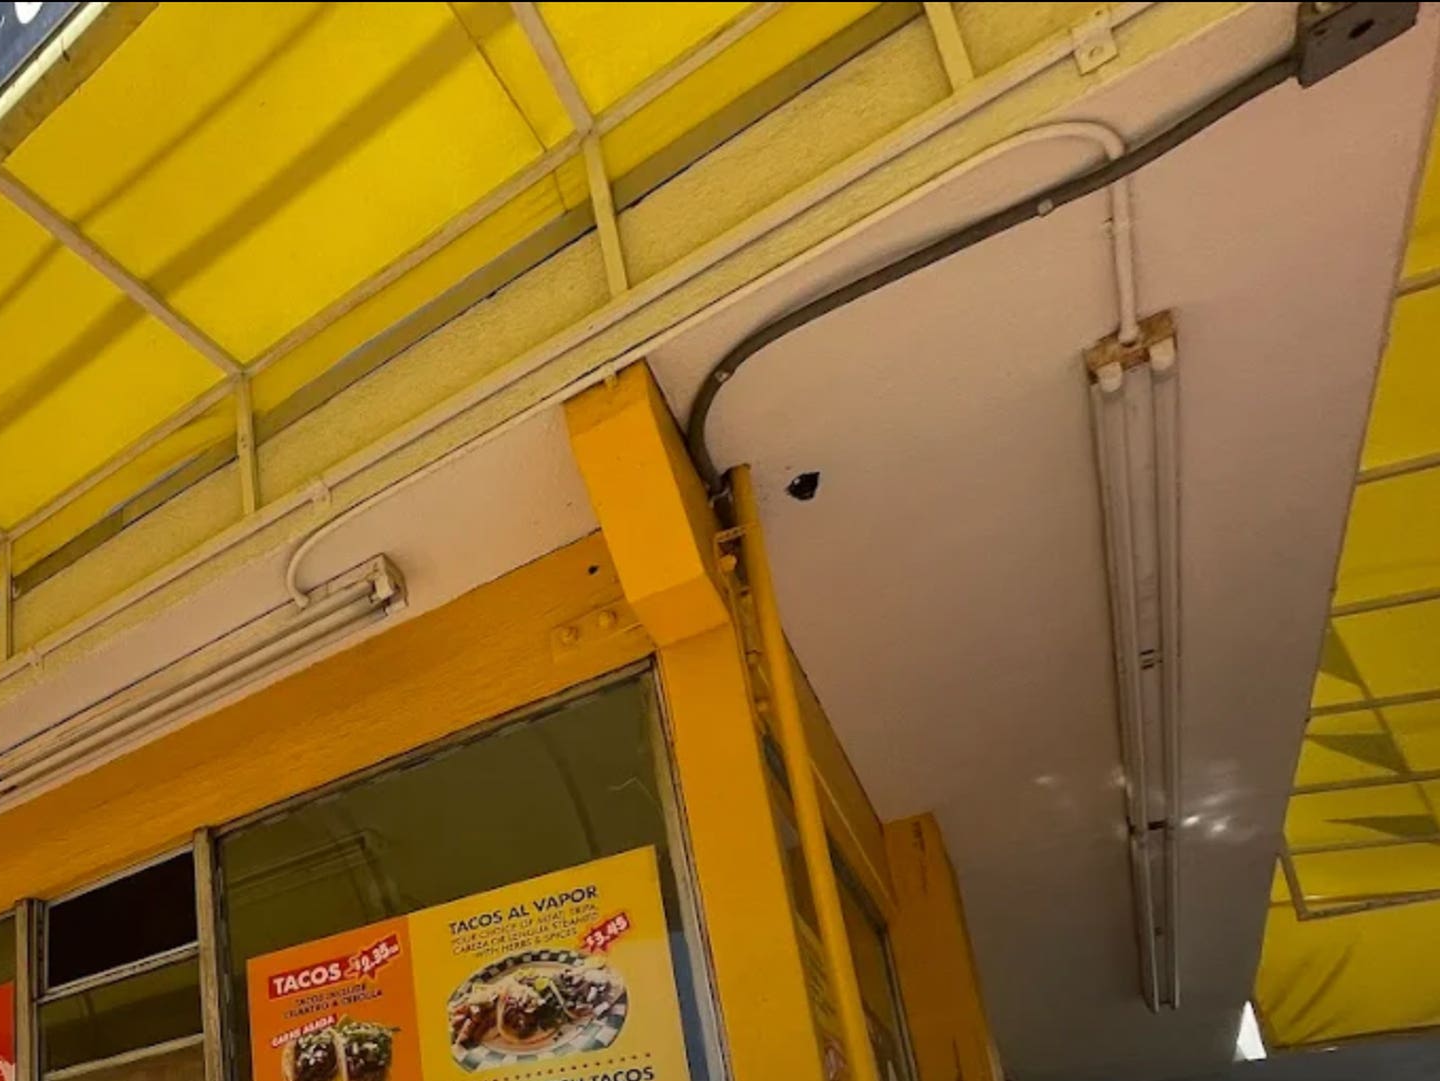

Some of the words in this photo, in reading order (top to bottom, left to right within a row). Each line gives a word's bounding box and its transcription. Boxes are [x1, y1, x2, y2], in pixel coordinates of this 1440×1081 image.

[450, 909, 503, 936] TACOS
[507, 903, 531, 920] AL
[532, 885, 598, 913] VAPOR
[272, 963, 342, 996] TACOS
[302, 1015, 336, 1036] ASADA
